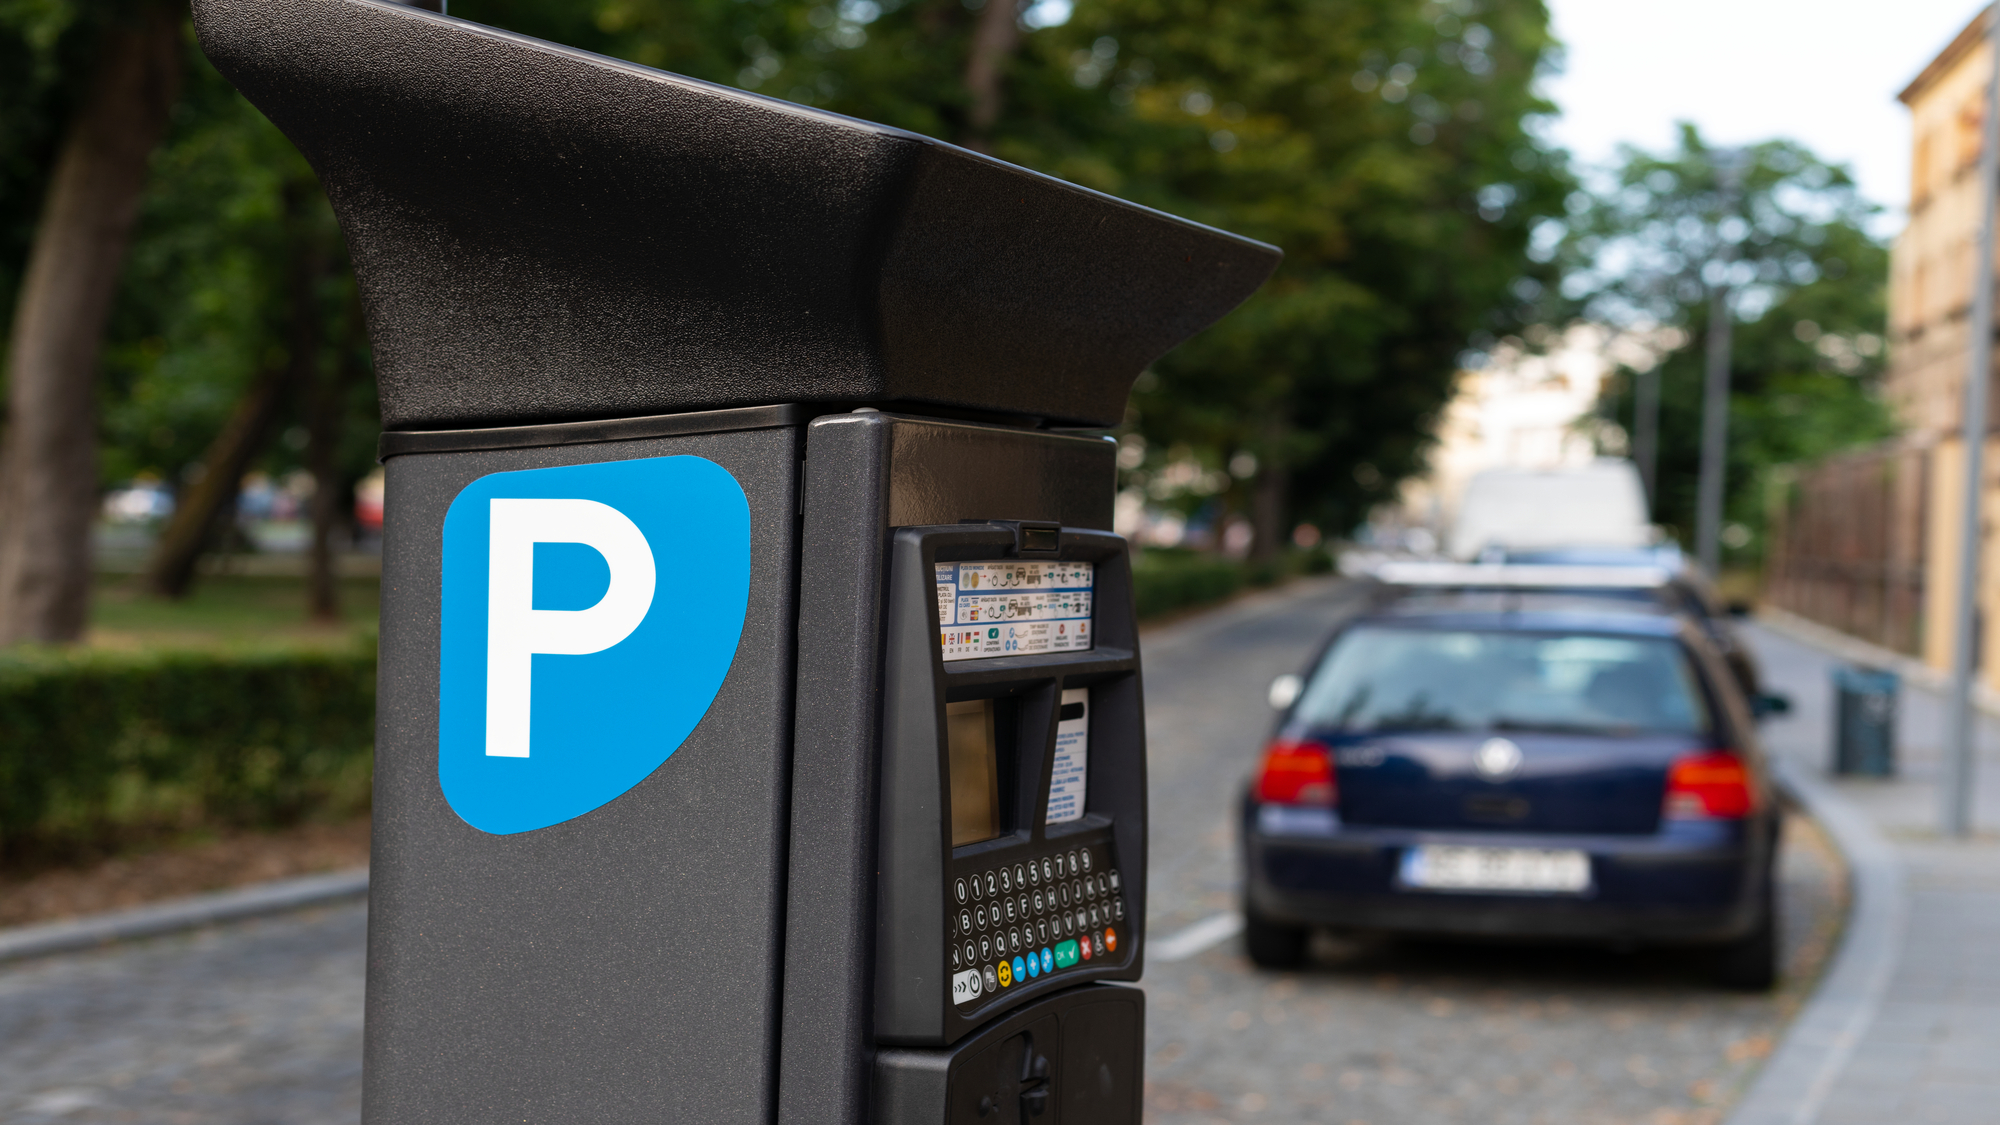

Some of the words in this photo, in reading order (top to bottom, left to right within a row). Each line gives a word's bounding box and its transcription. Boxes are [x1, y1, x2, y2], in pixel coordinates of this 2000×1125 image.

[485, 498, 656, 758] P
[958, 882, 965, 900] 0
[973, 879, 980, 896] 1
[987, 875, 996, 893] 2
[1002, 872, 1010, 889] 3
[1017, 868, 1024, 884] 4
[1030, 864, 1038, 881] 5
[1044, 862, 1051, 878] 6
[1056, 858, 1063, 874] 7
[1070, 855, 1077, 871] 8
[1083, 852, 1089, 868] 9
[962, 914, 970, 930] B
[977, 910, 985, 925] C
[992, 906, 1000, 921] D
[1006, 902, 1014, 917] E
[1021, 898, 1027, 913] F
[1034, 895, 1042, 909] G
[1048, 892, 1056, 905] H
[1063, 889, 1067, 901] I
[1075, 885, 1080, 898] J
[1086, 882, 1094, 894] K
[1099, 878, 1106, 891] L
[966, 945, 974, 960] O
[982, 941, 989, 956] P
[996, 936, 1005, 951] Q
[1011, 932, 1019, 947] R
[1025, 928, 1033, 943] S
[1039, 924, 1045, 938] T
[1052, 920, 1060, 934] U
[1065, 917, 1072, 930] V
[1077, 913, 1086, 926] W
[1091, 910, 1098, 922] X
[1102, 906, 1110, 919] Y
[1115, 901, 1122, 916] Z
[1056, 950, 1066, 961] OK
